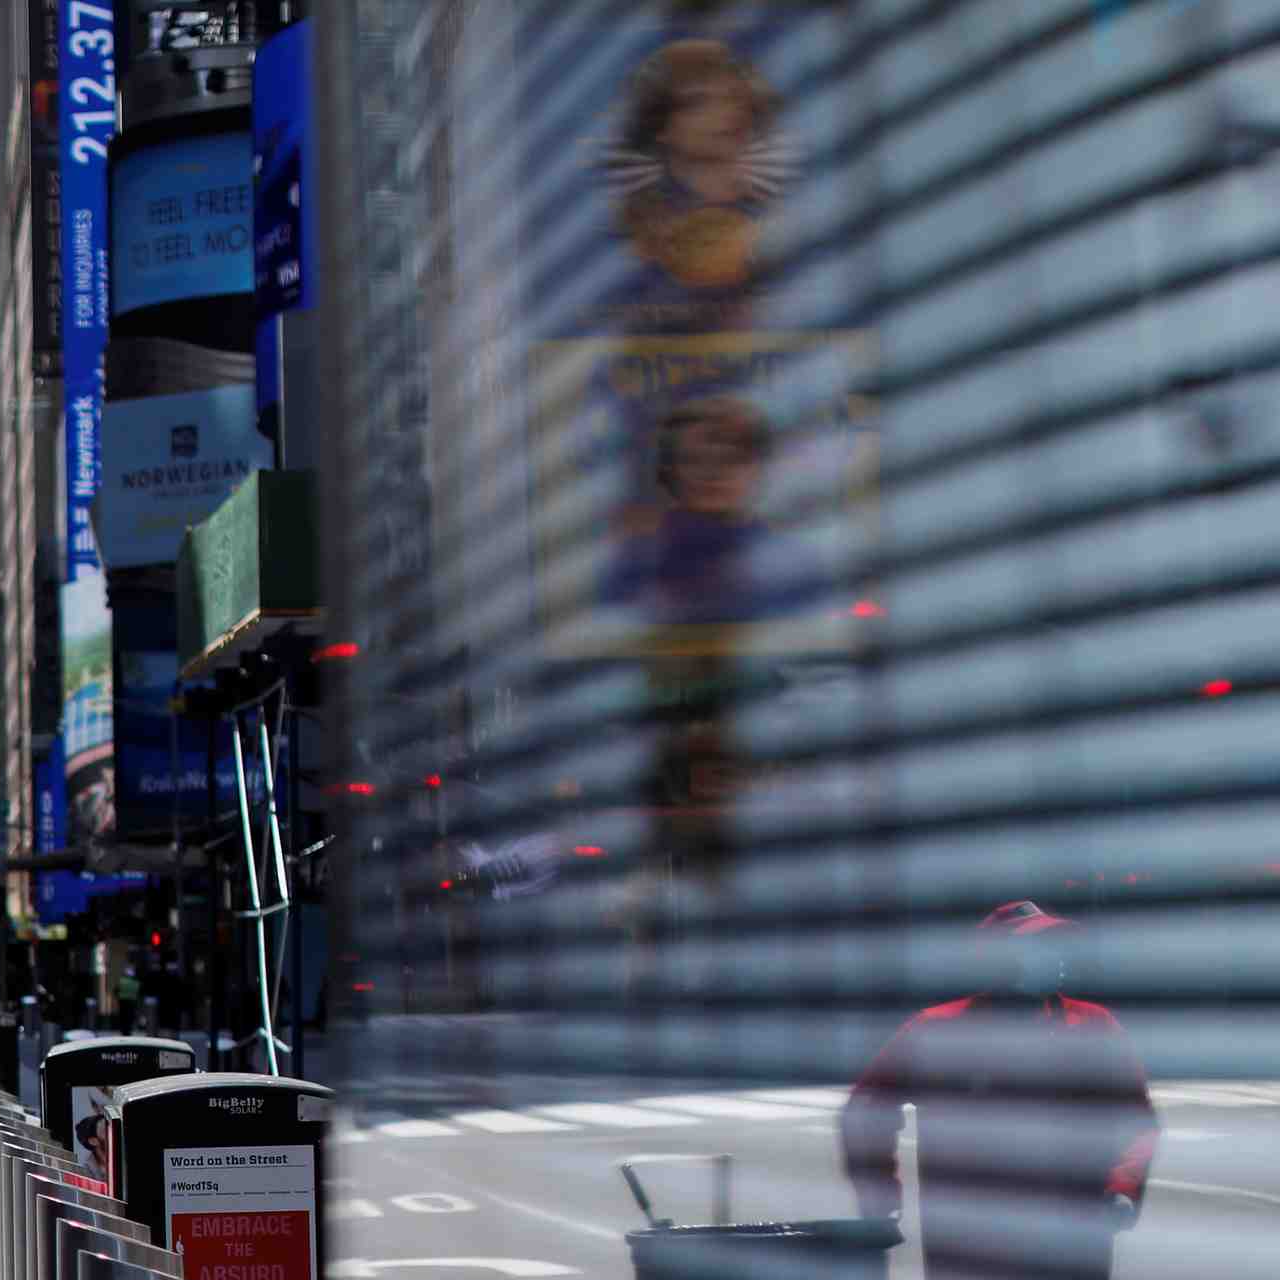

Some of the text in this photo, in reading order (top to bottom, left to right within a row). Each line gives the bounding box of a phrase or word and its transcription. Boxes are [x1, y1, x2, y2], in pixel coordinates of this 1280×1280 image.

[208, 1096, 264, 1110] BigBelly
[170, 1154, 288, 1167] Word on the Street
[191, 1216, 293, 1238] EMBRACE
[224, 1242, 256, 1257] THE
